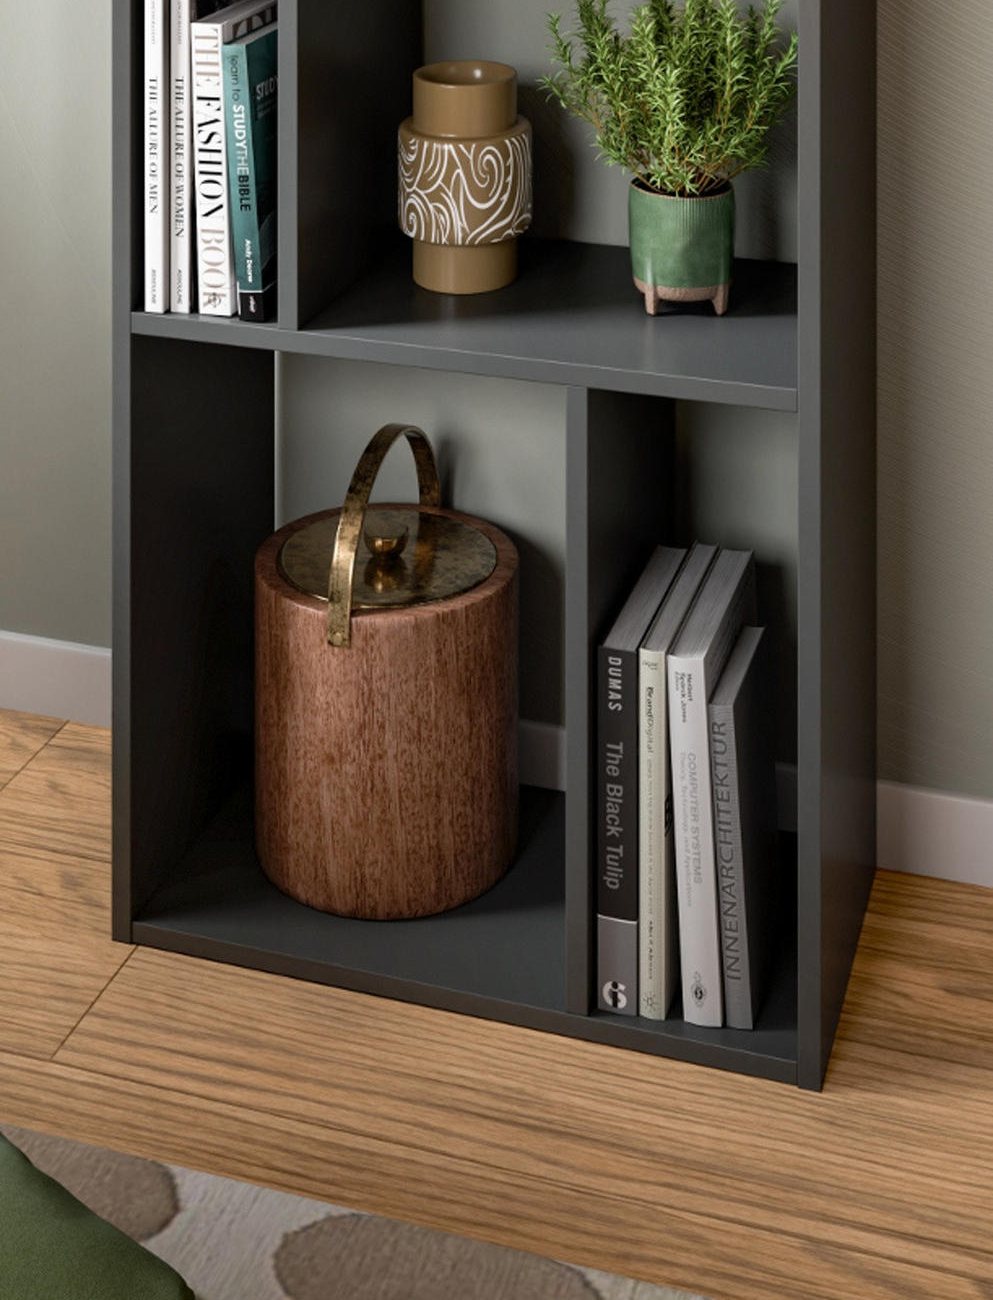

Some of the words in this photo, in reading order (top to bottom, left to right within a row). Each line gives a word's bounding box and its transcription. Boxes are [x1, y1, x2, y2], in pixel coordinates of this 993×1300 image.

[194, 28, 220, 88] THE
[229, 54, 241, 86] learn
[148, 75, 158, 105] THE
[174, 75, 185, 105] THE
[232, 88, 242, 102] to
[148, 107, 158, 161] ALLURE
[174, 107, 185, 161] ALLURE
[197, 95, 225, 222] FASHION
[149, 162, 158, 181] OF
[174, 162, 185, 180] OF
[149, 183, 158, 215] MEN
[174, 183, 185, 239] WOMEN
[200, 228, 227, 309] BOOK
[608, 656, 623, 712] DUMAS
[606, 740, 624, 778] The
[605, 783, 623, 838] Black
[687, 752, 699, 823] COMPUTER
[603, 844, 623, 891] Tulip
[691, 826, 703, 886] SYSTEMS
[712, 722, 741, 980] INNENARCHITEKTUR
